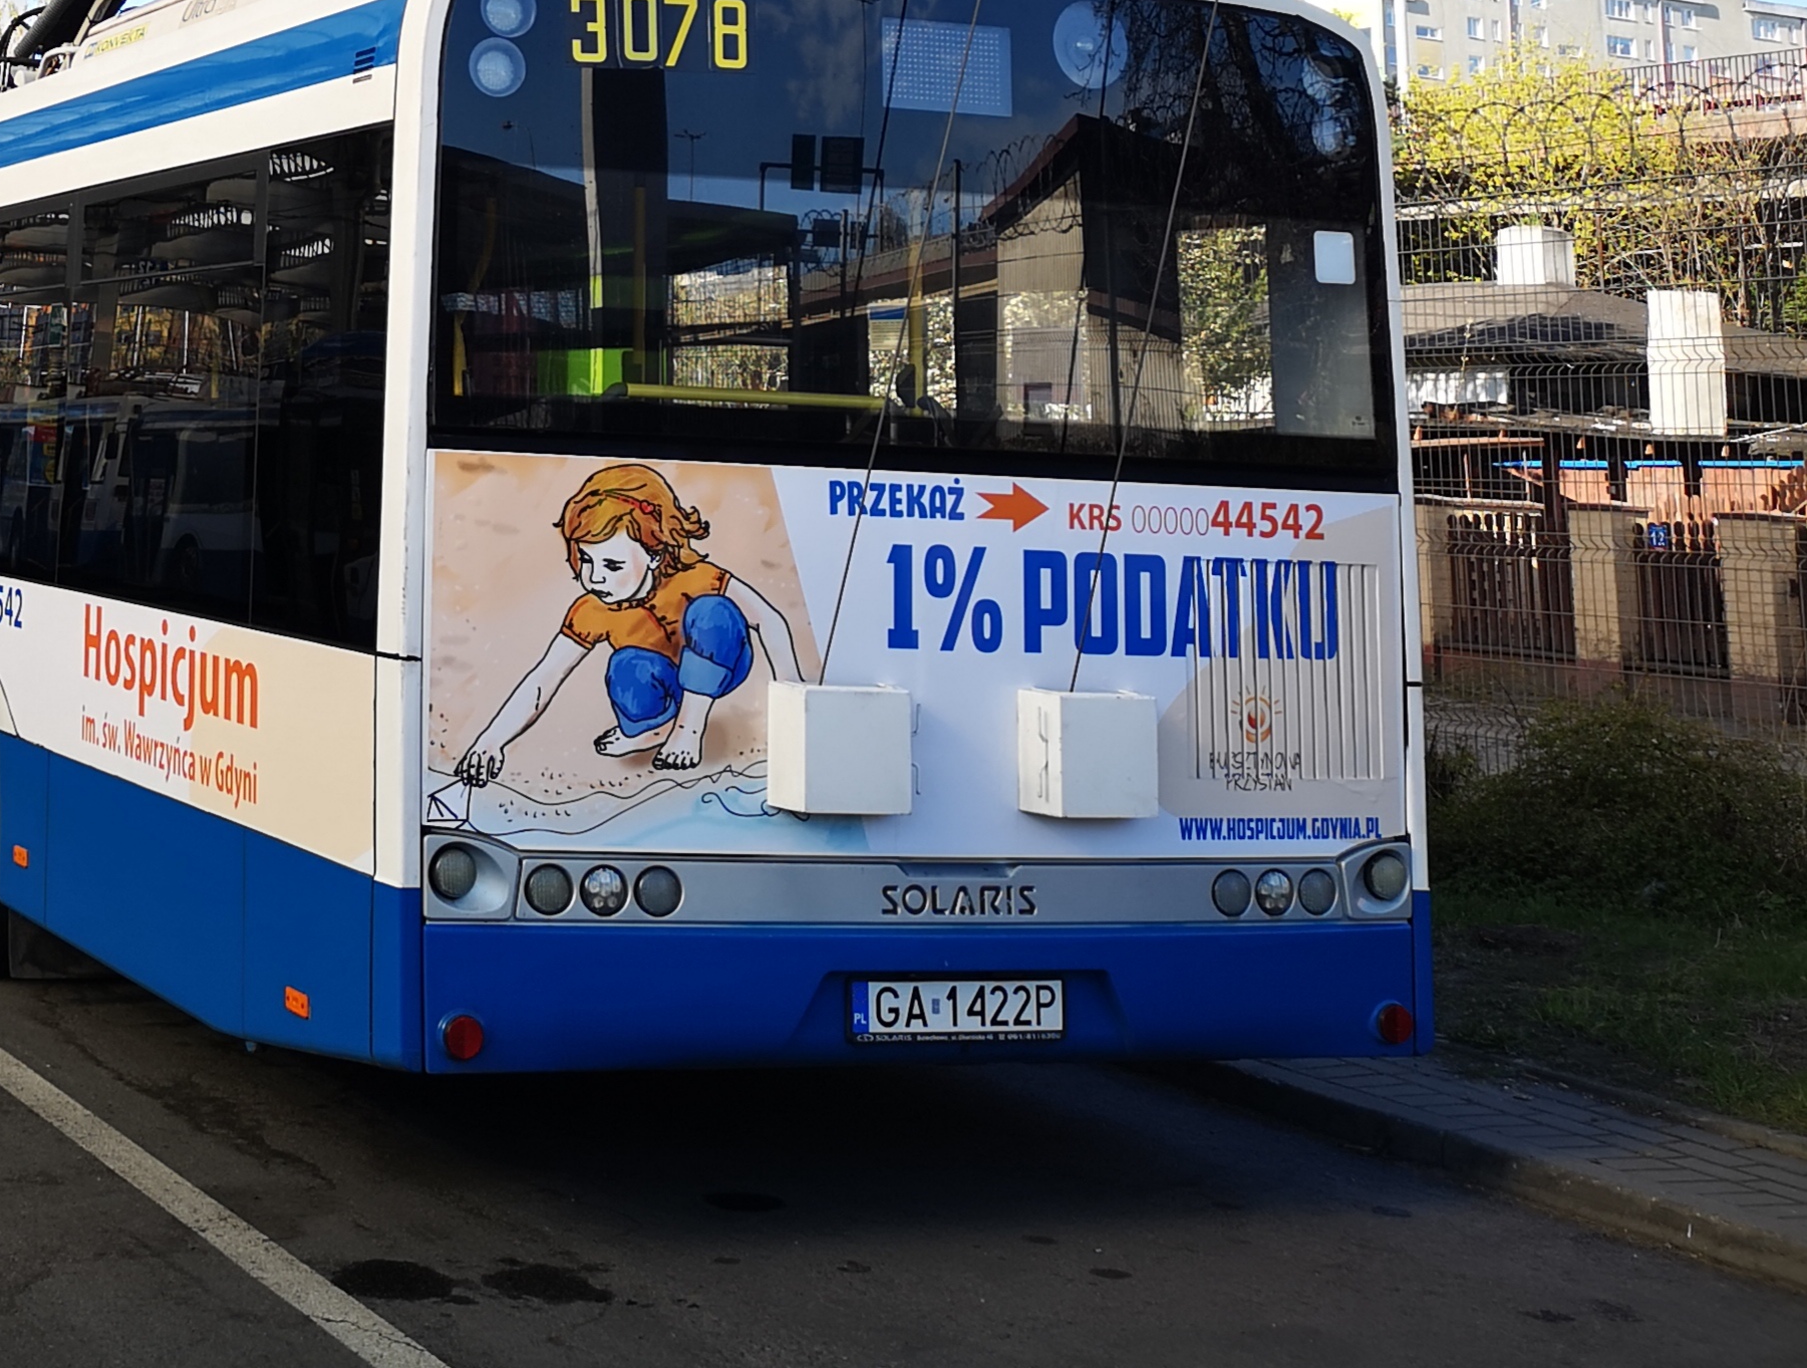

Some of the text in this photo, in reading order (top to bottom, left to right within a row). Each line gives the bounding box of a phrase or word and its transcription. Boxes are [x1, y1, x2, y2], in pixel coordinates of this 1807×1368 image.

[828, 477, 1326, 541] PRZEKAŻ KRS 0000044542
[1650, 531, 1666, 546] 12
[886, 543, 1339, 662] 1% PODATKU
[83, 603, 258, 732] Hospicjum
[81, 704, 257, 809] im. św. Wawrzyńca w Gdyni
[1179, 816, 1382, 841] WWW.HOSPICJUM.GDYNIA.PL
[881, 884, 1037, 915] SOLARIS
[853, 1013, 867, 1024] PL
[875, 984, 1056, 1028] GA 1422P
[875, 1034, 912, 1042] SOLARIS
